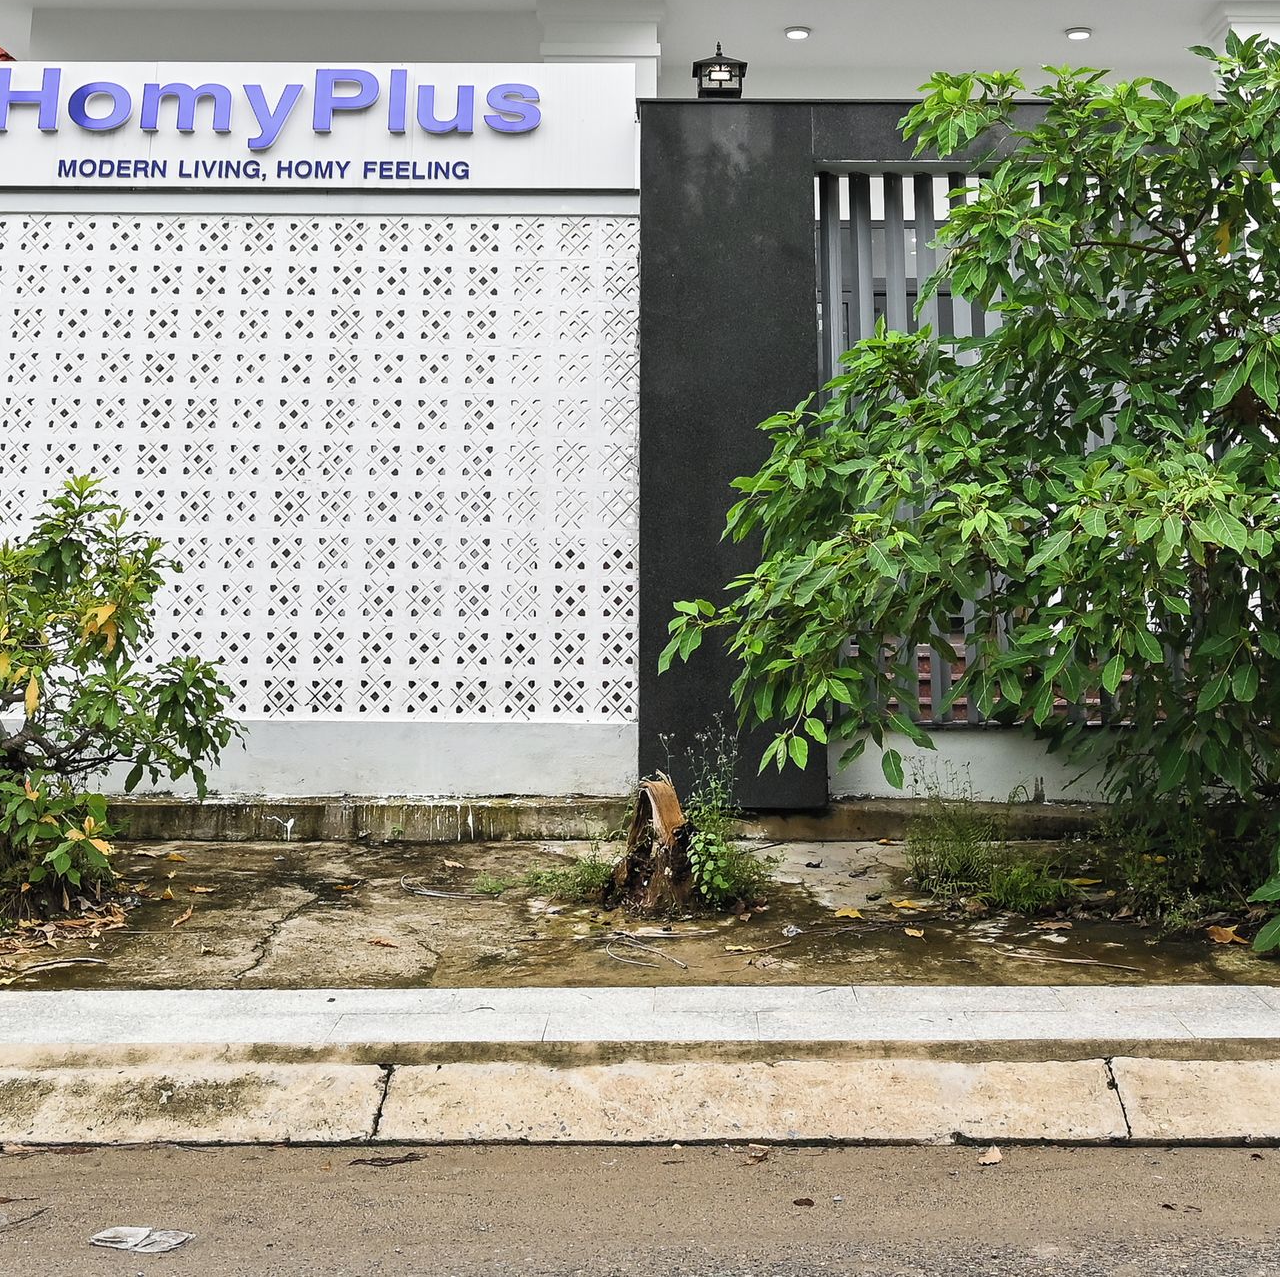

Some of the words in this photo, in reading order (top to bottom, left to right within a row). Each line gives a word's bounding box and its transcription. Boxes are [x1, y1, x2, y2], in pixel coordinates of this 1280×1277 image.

[57, 159, 167, 180] MODERN
[178, 159, 267, 182] LIVING,
[277, 160, 351, 180] HOMY
[363, 160, 470, 181] FEELING
